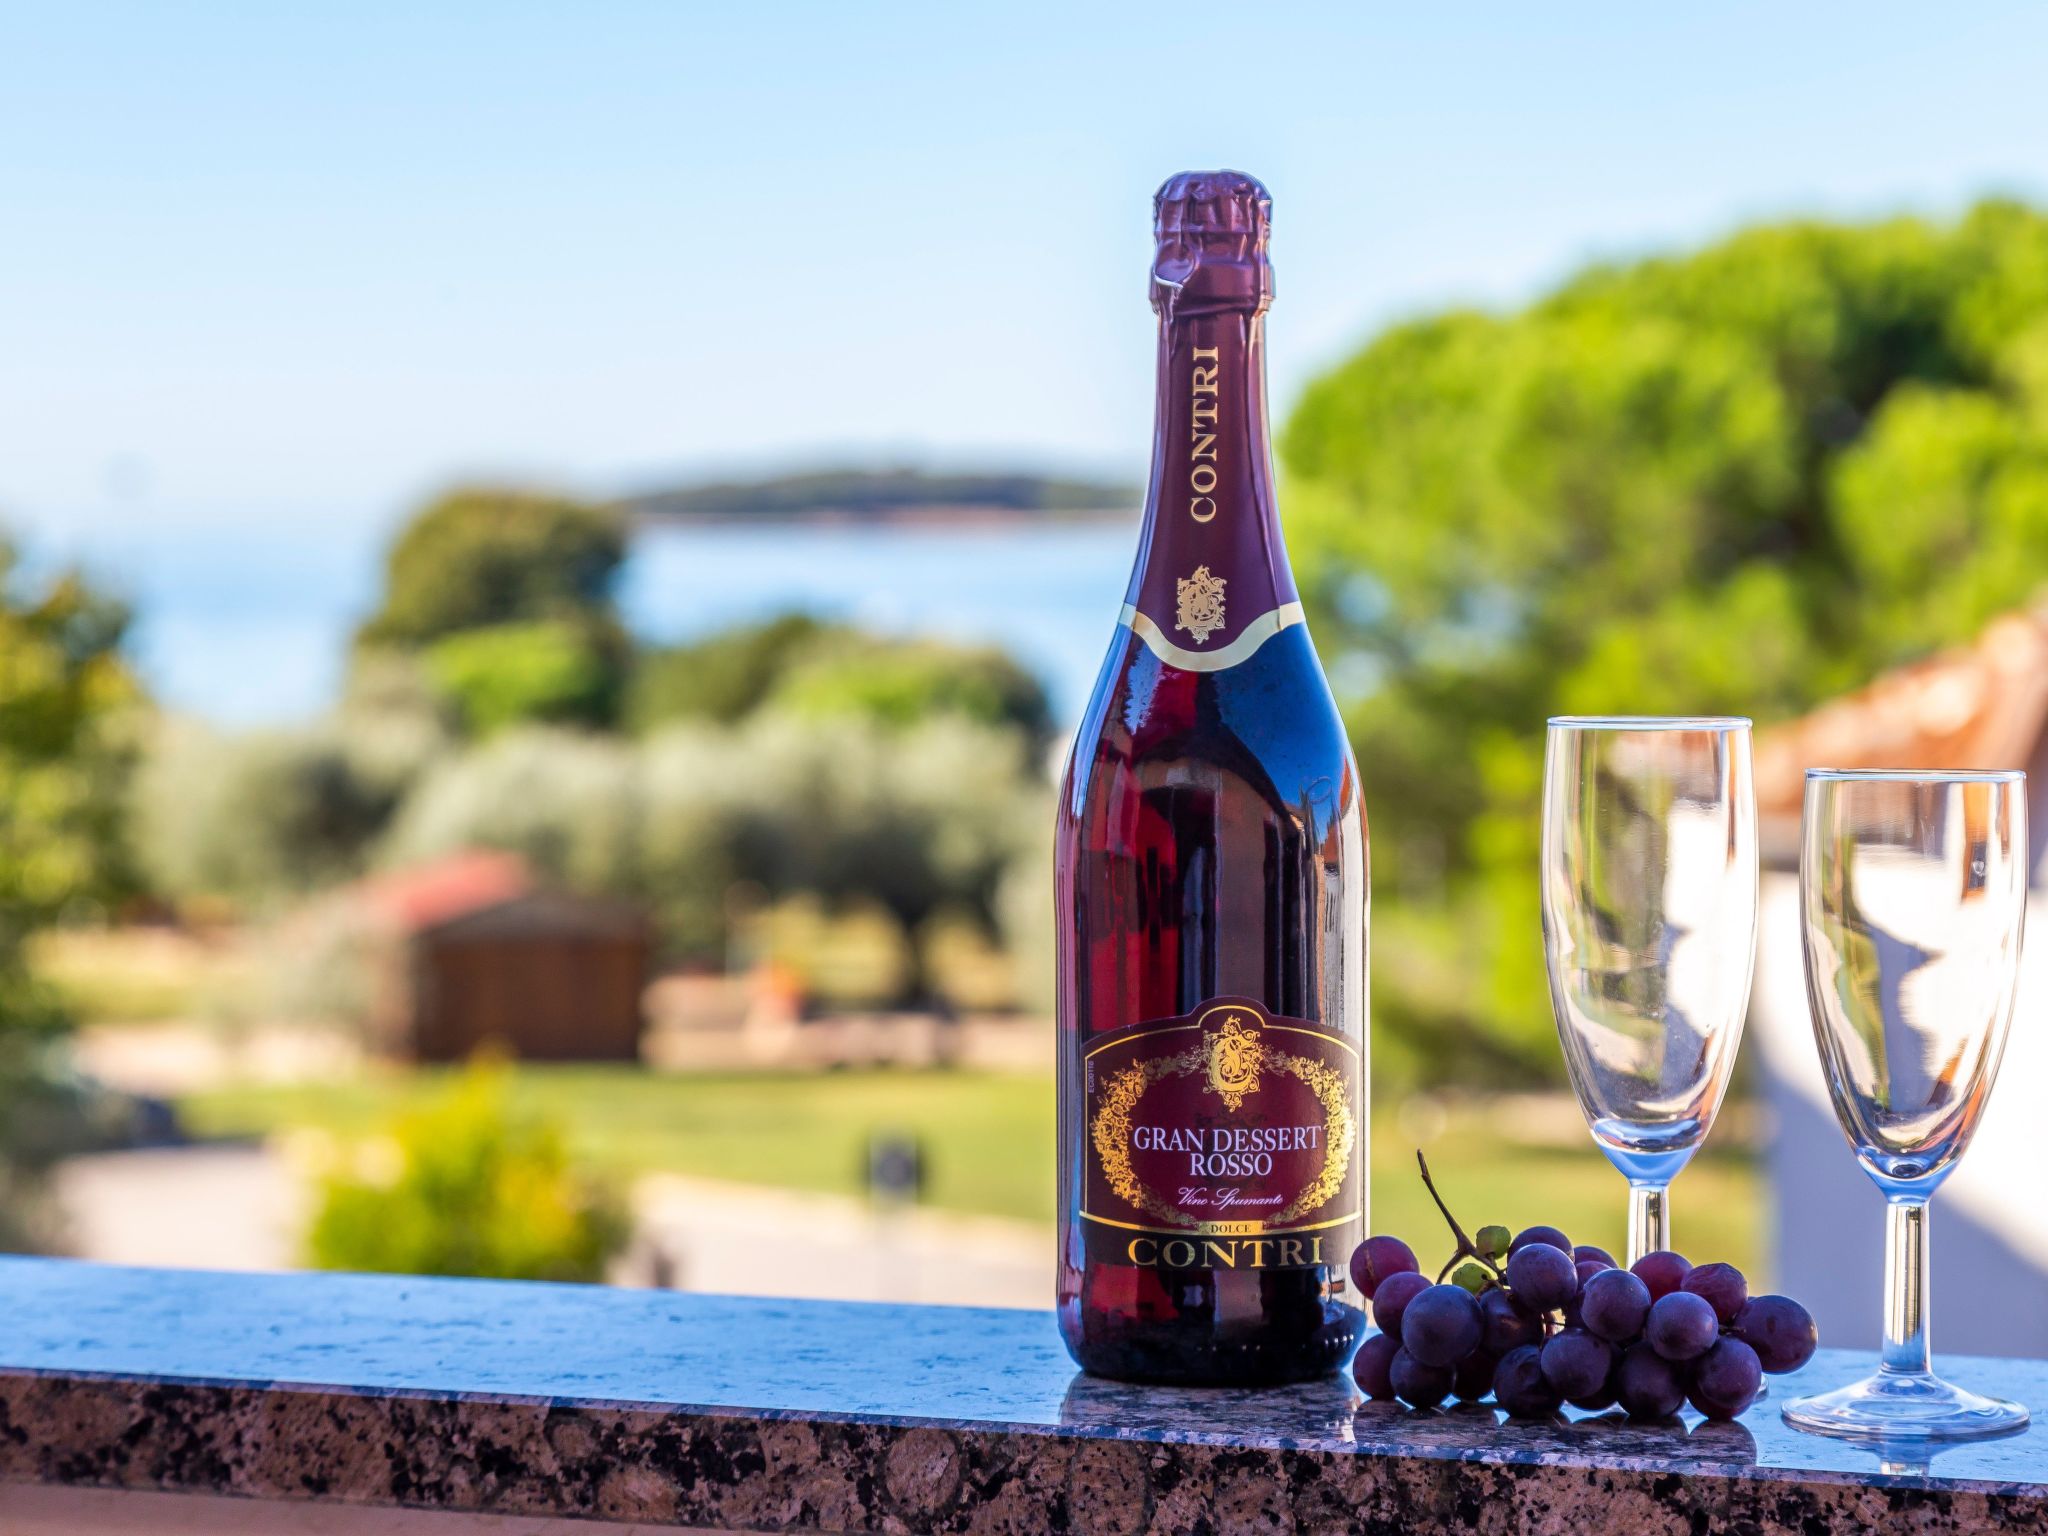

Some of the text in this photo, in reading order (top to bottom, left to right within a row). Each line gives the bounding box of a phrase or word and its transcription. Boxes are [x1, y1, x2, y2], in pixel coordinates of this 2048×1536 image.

[1190, 345, 1219, 524] CONTRI
[1133, 1125, 1322, 1153] GRAN DESSERT
[1189, 1152, 1273, 1176] ROSSO
[1177, 1186, 1284, 1211] Vino Spumante
[1210, 1223, 1252, 1233] DOLCE
[1127, 1236, 1324, 1268] CONTRI
